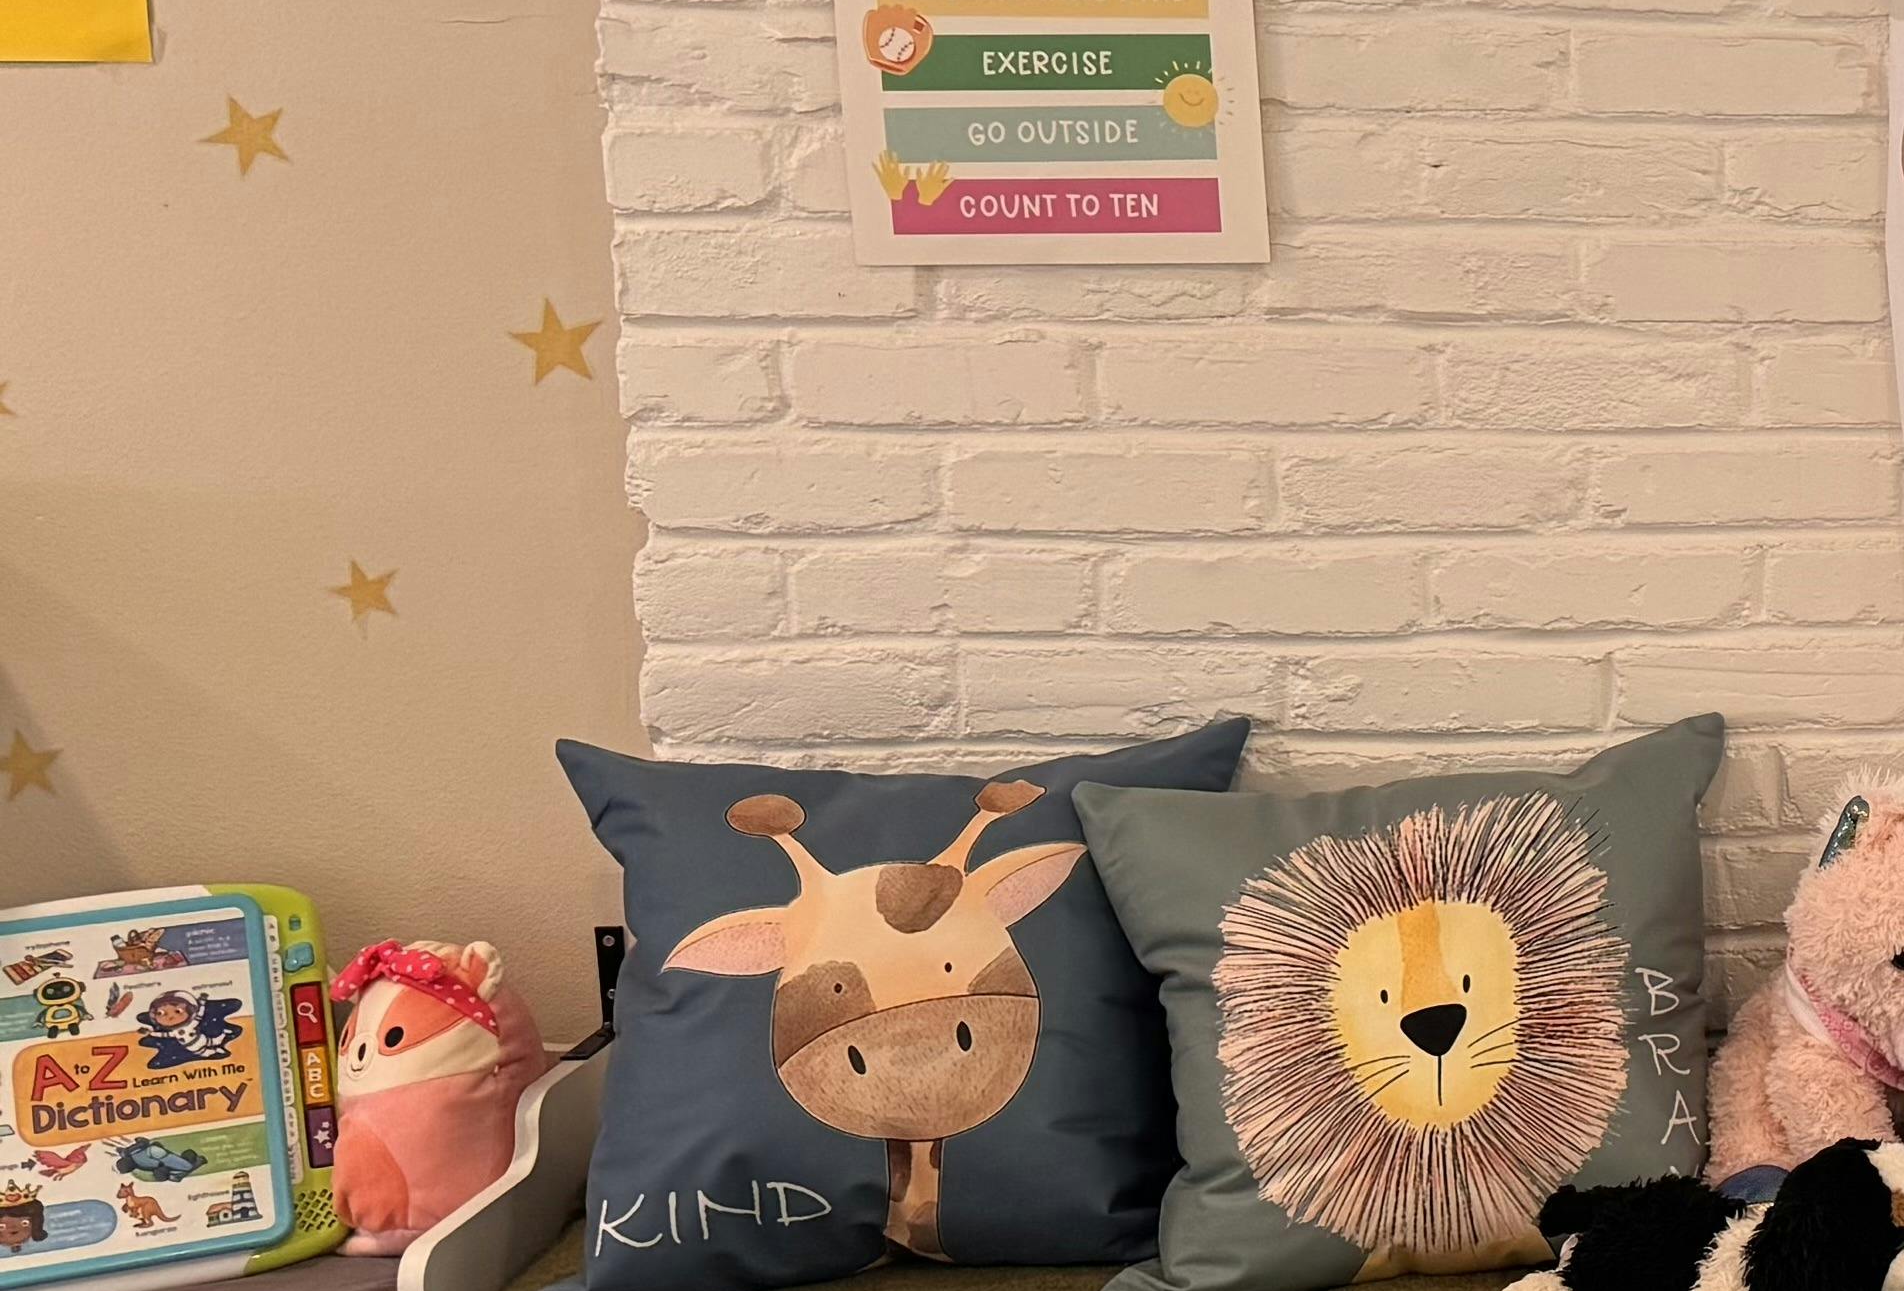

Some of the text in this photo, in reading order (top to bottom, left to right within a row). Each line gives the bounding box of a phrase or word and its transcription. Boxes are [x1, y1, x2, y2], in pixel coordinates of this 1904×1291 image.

[982, 50, 1113, 76] EXERCISE
[967, 120, 1139, 146] GO OUTSIDE
[959, 193, 1159, 219] COUNT TO TEN
[30, 1046, 129, 1101] A to Z
[132, 1075, 179, 1088] Learn
[222, 1063, 245, 1075] Me
[1634, 967, 1701, 1172] BRA
[31, 1082, 248, 1135] Dictionary
[595, 1179, 832, 1257] KIND
